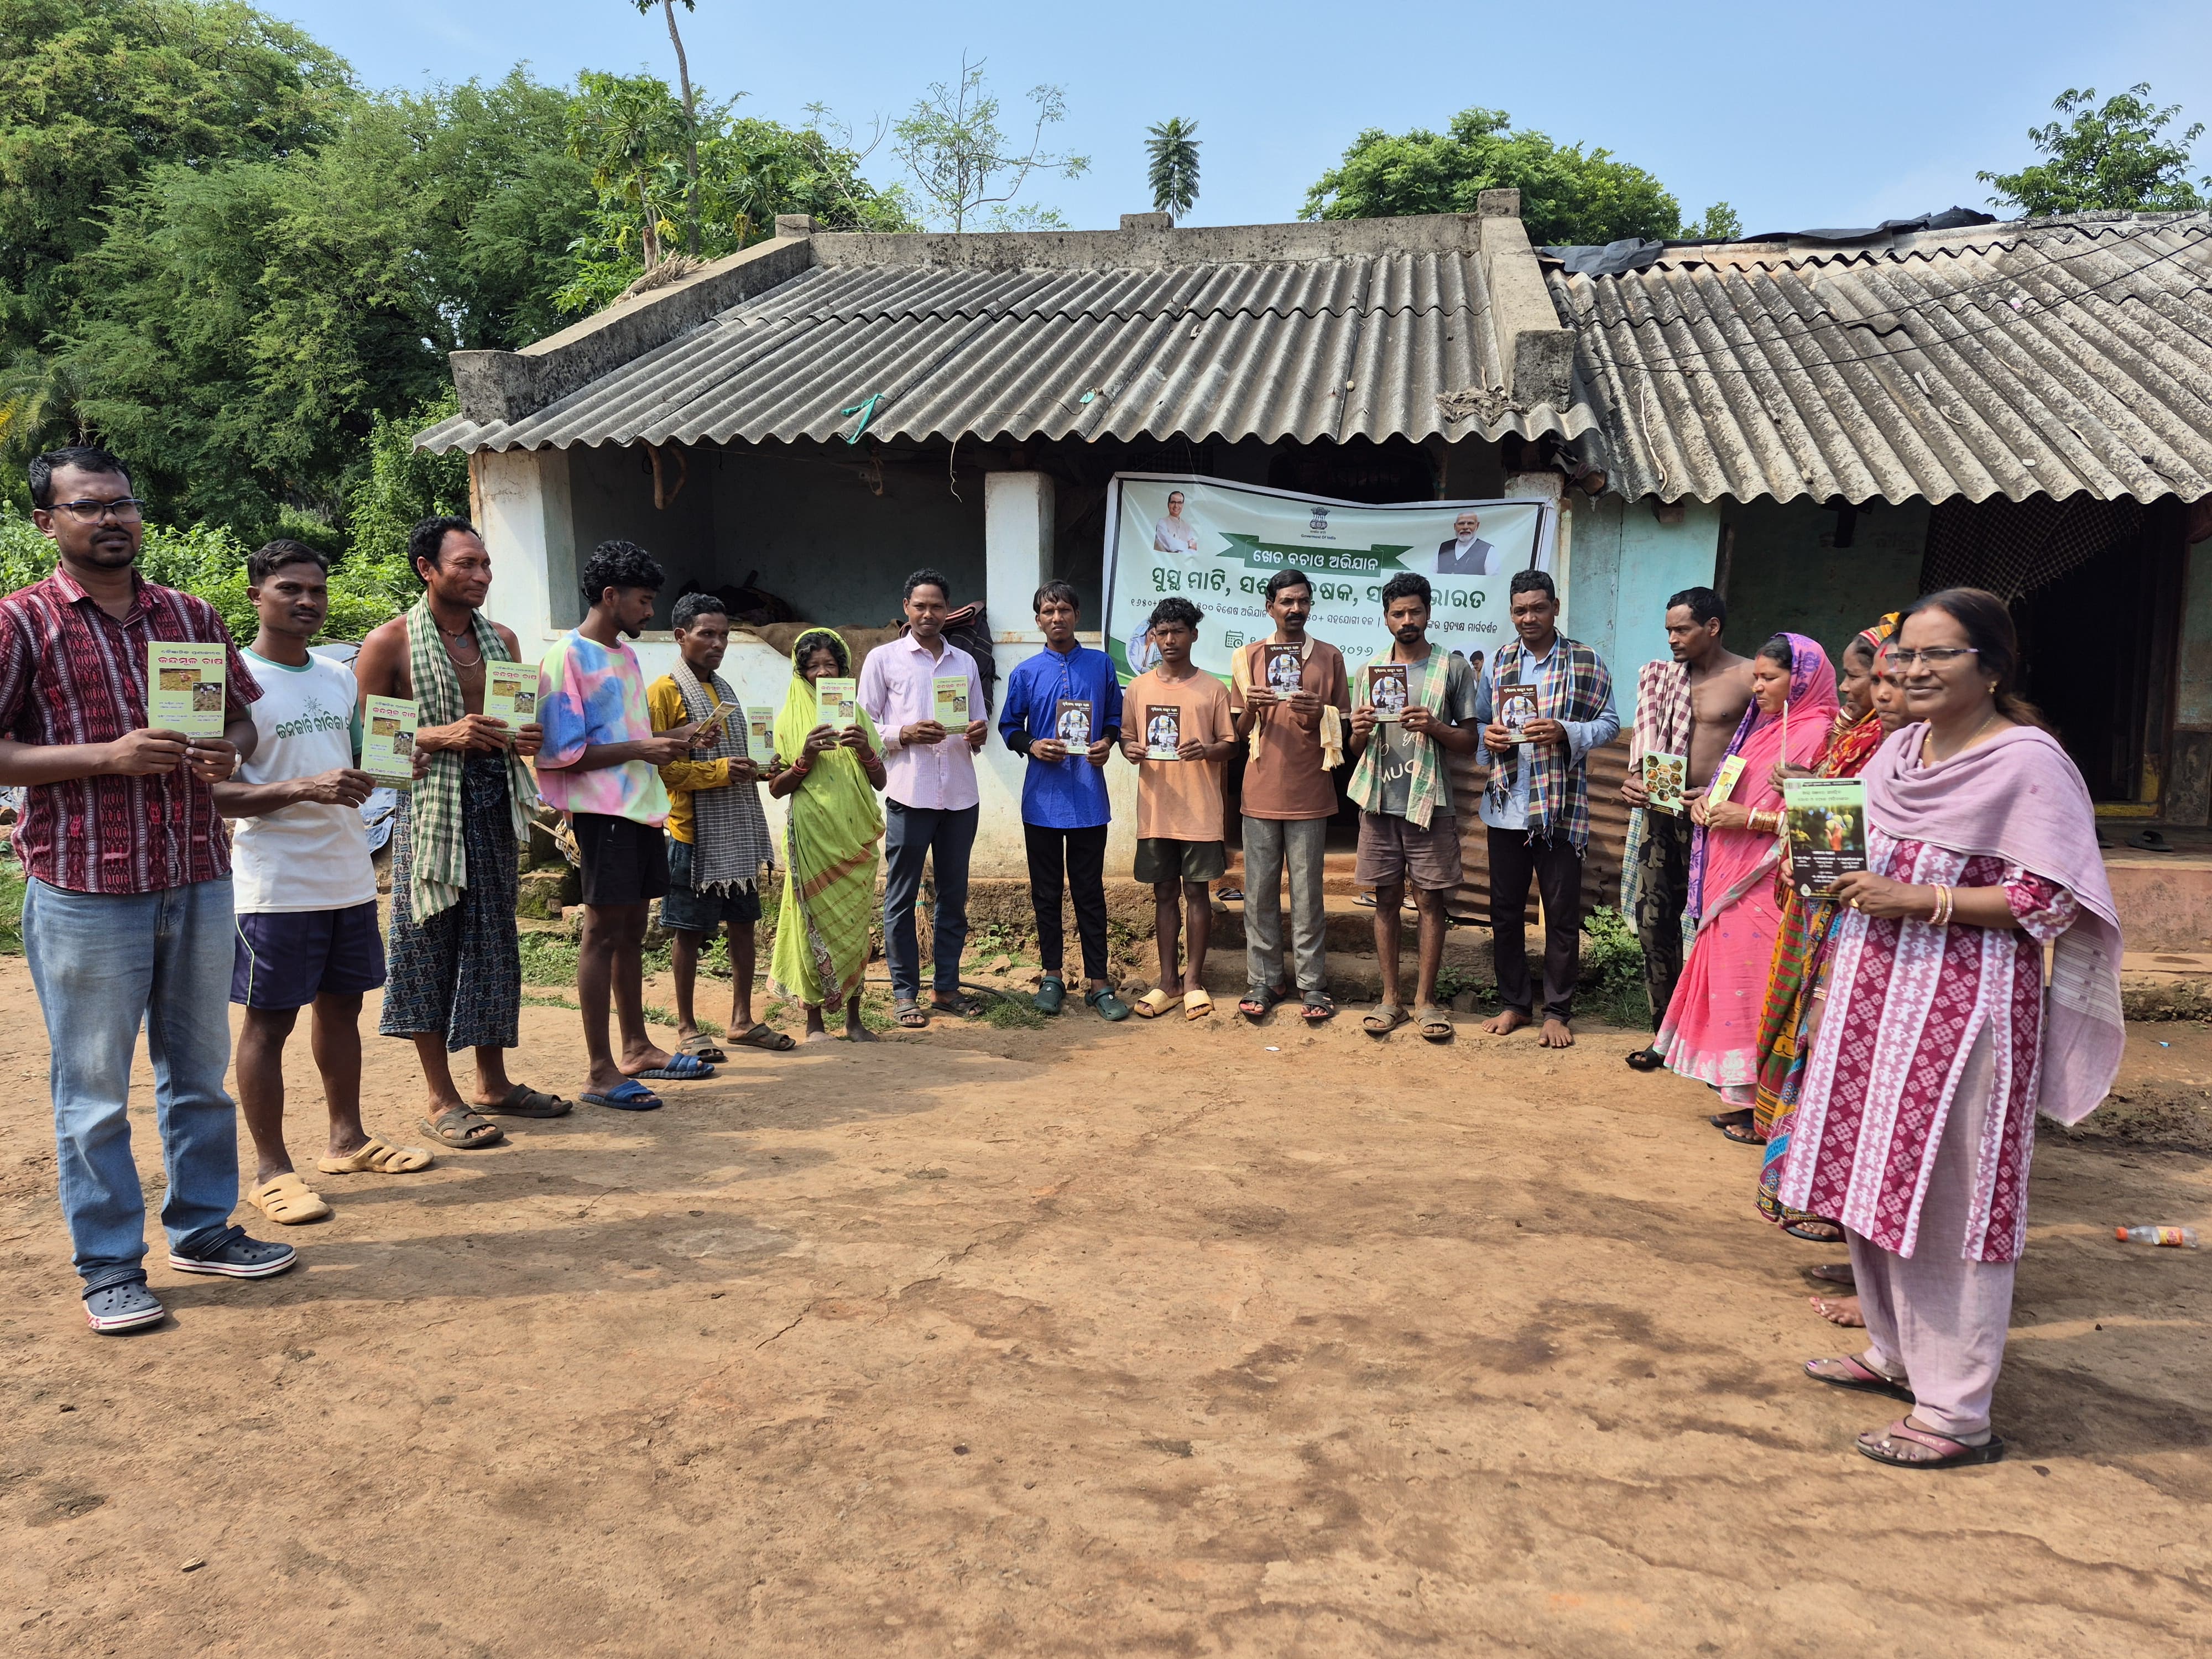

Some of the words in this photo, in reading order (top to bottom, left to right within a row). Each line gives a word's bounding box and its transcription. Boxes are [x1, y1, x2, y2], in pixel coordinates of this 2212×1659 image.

[1253, 550, 1283, 564] ଖେତ
[1288, 553, 1324, 567] ବଚାଓ
[1329, 554, 1379, 571] ଅଭିଯାନ
[1152, 567, 1181, 592] ସୁସ୍ଥ
[1188, 568, 1231, 597] ମାଟି,
[1216, 603, 1238, 615] ବିଶେଷ
